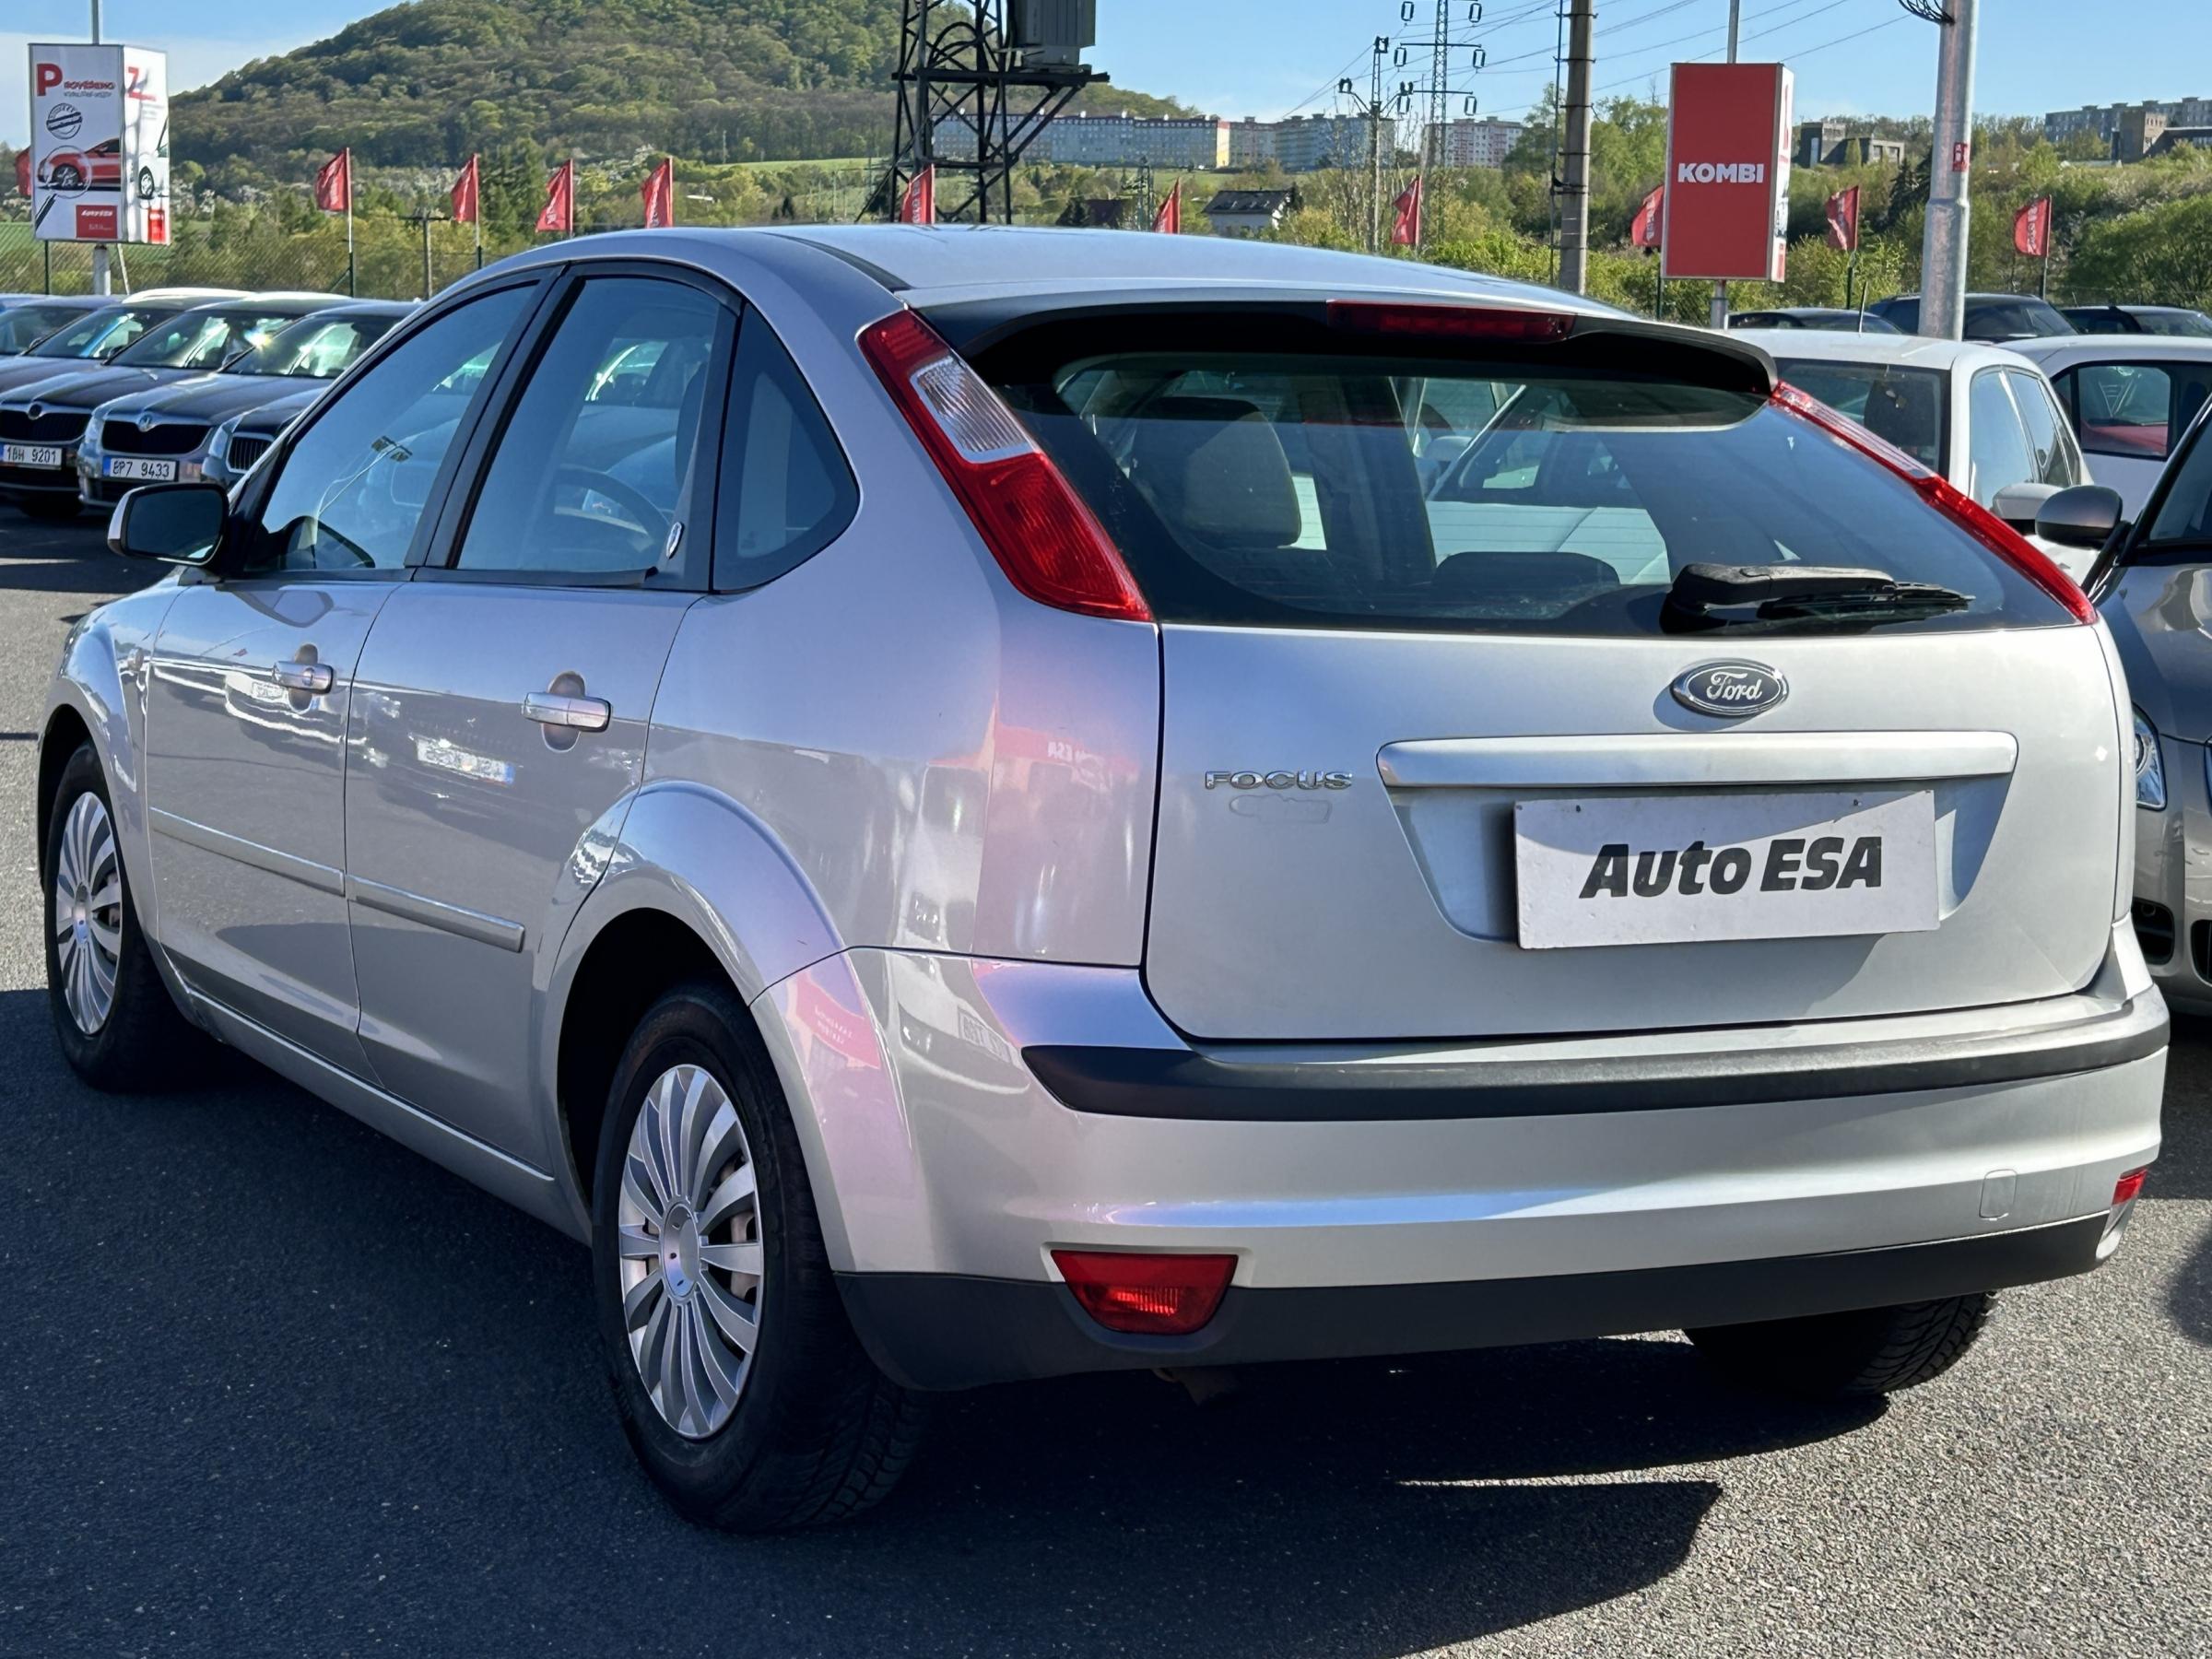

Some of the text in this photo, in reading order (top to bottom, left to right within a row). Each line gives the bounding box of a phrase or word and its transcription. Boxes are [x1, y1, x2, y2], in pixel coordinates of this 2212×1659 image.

[1677, 162, 1765, 183] KOMBI
[31, 448, 57, 464] 9201
[141, 462, 170, 478] 9433
[1706, 671, 1762, 700] Ford
[1205, 770, 1353, 791] FOCUS
[1579, 836, 1882, 899] Auto ESA
